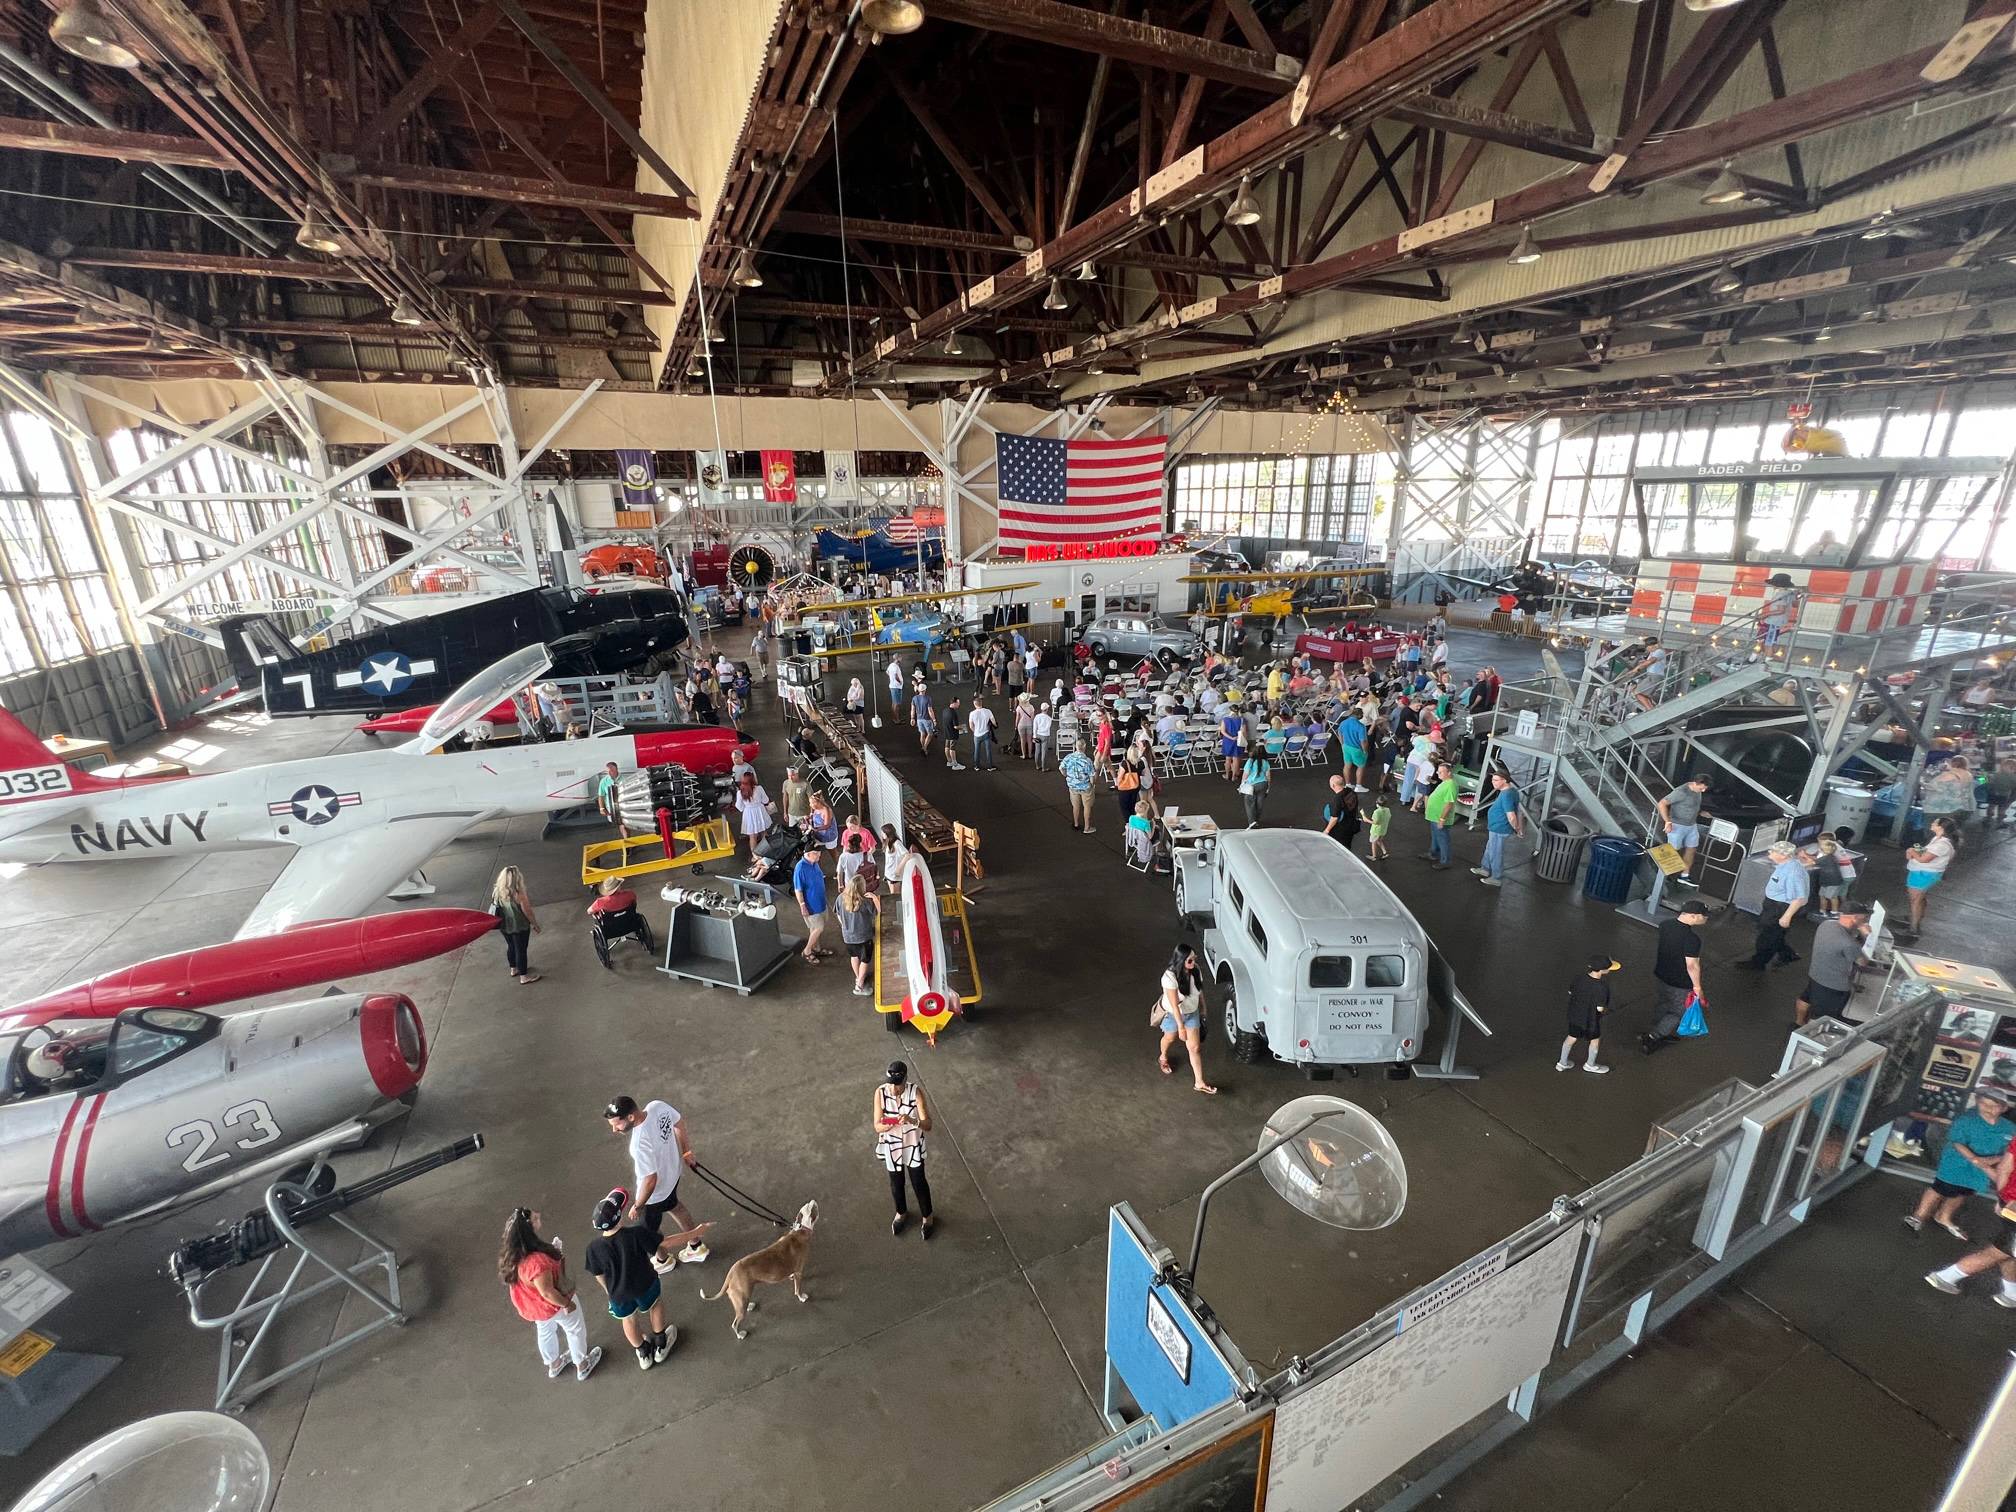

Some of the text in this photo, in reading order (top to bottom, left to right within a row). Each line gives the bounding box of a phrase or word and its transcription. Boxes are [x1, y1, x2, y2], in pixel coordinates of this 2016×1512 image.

[1698, 463, 1803, 475] BADER FIELD
[1026, 540, 1158, 562] NAS WILDWOOD
[187, 598, 315, 616] WELCOME ABOARD
[1521, 724, 1531, 736] 11
[70, 810, 209, 854] NAVY
[1350, 935, 1369, 944] 301
[1338, 1011, 1373, 1019] CONVOY
[165, 1099, 282, 1173] 23
[1409, 1288, 1448, 1314] VETERAN'S
[1477, 1255, 1500, 1273] BOARD
[1413, 1266, 1496, 1322] ASK GIFT SHOP FOR PEN
